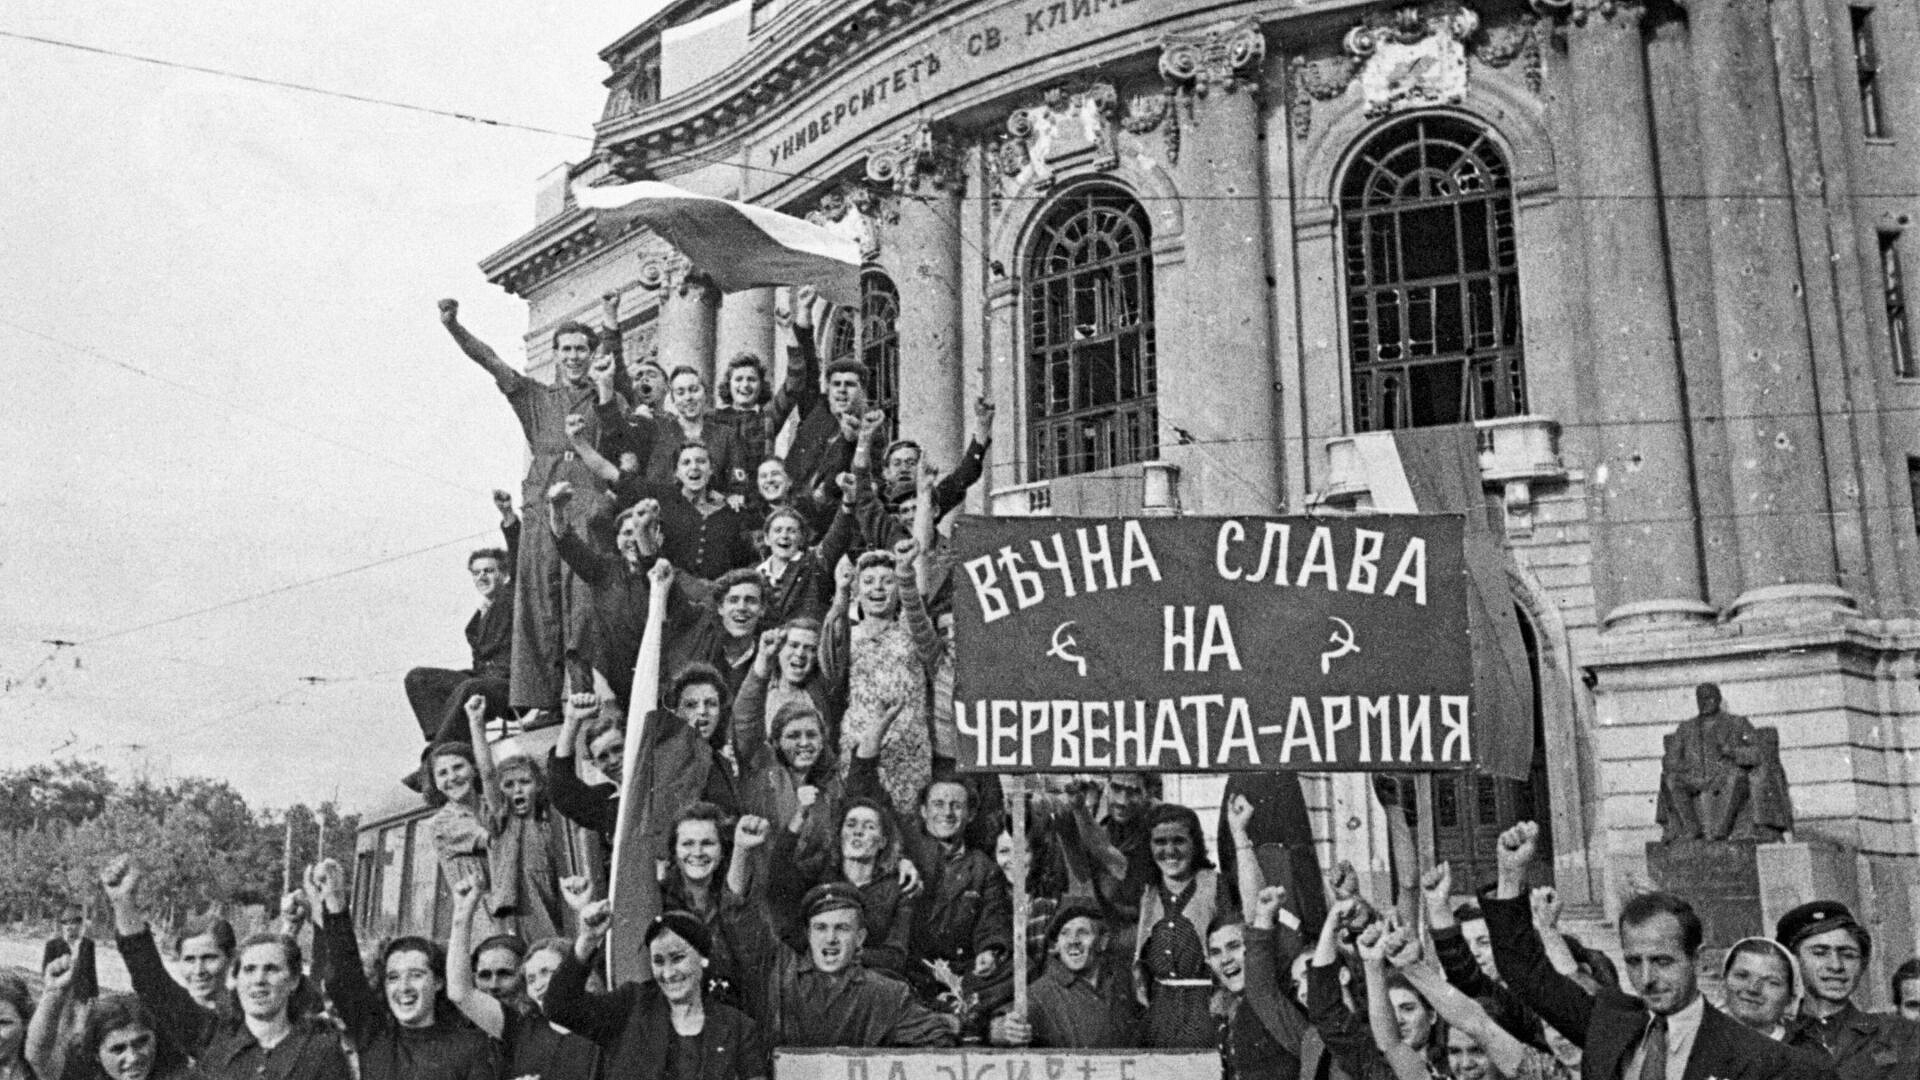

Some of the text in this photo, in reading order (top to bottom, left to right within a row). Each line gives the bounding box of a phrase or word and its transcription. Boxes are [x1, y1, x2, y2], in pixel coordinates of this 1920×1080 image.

[769, 53, 941, 167] УНИВЕРСИТЕТЪ
[964, 520, 1427, 623] ВѢЧНА СЛАВА
[1164, 605, 1242, 671] НА
[955, 694, 1471, 768] ЧЕРВЕНАТА-АРМИЯ
